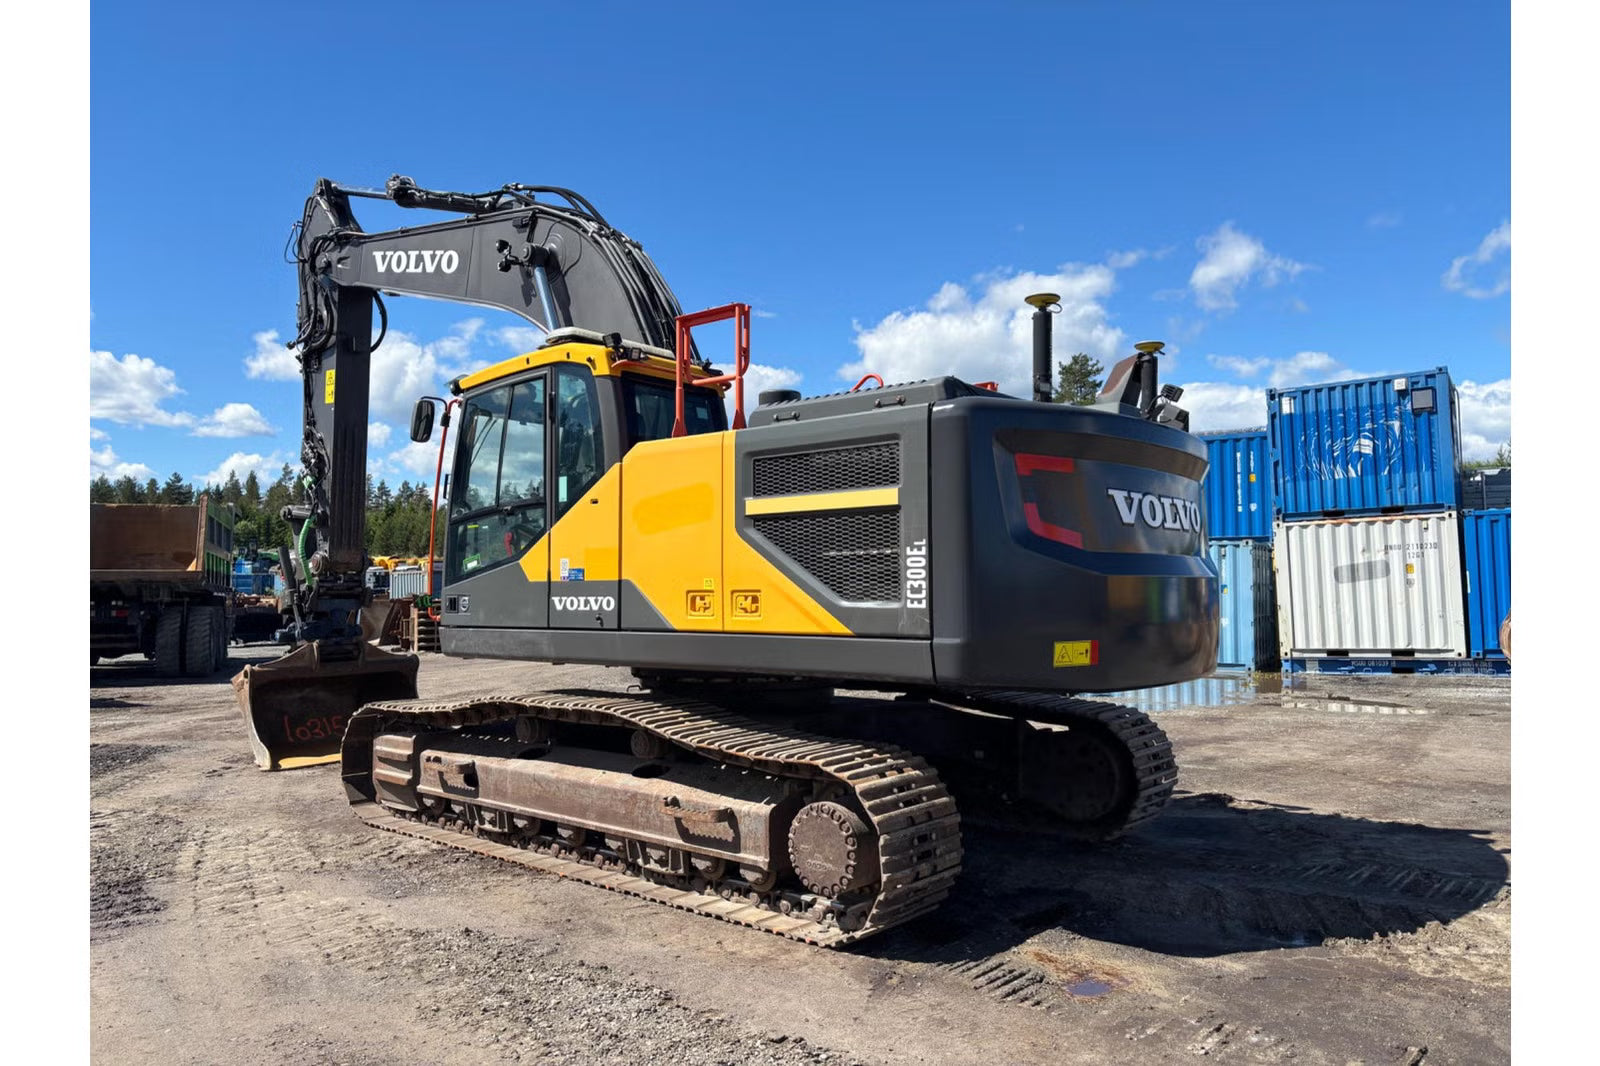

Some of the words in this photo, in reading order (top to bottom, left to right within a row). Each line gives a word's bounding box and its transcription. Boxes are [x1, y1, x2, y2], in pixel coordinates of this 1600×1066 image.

[372, 249, 459, 274] VOLVO
[1107, 488, 1201, 533] VOLVO
[551, 596, 615, 611] VOLVO
